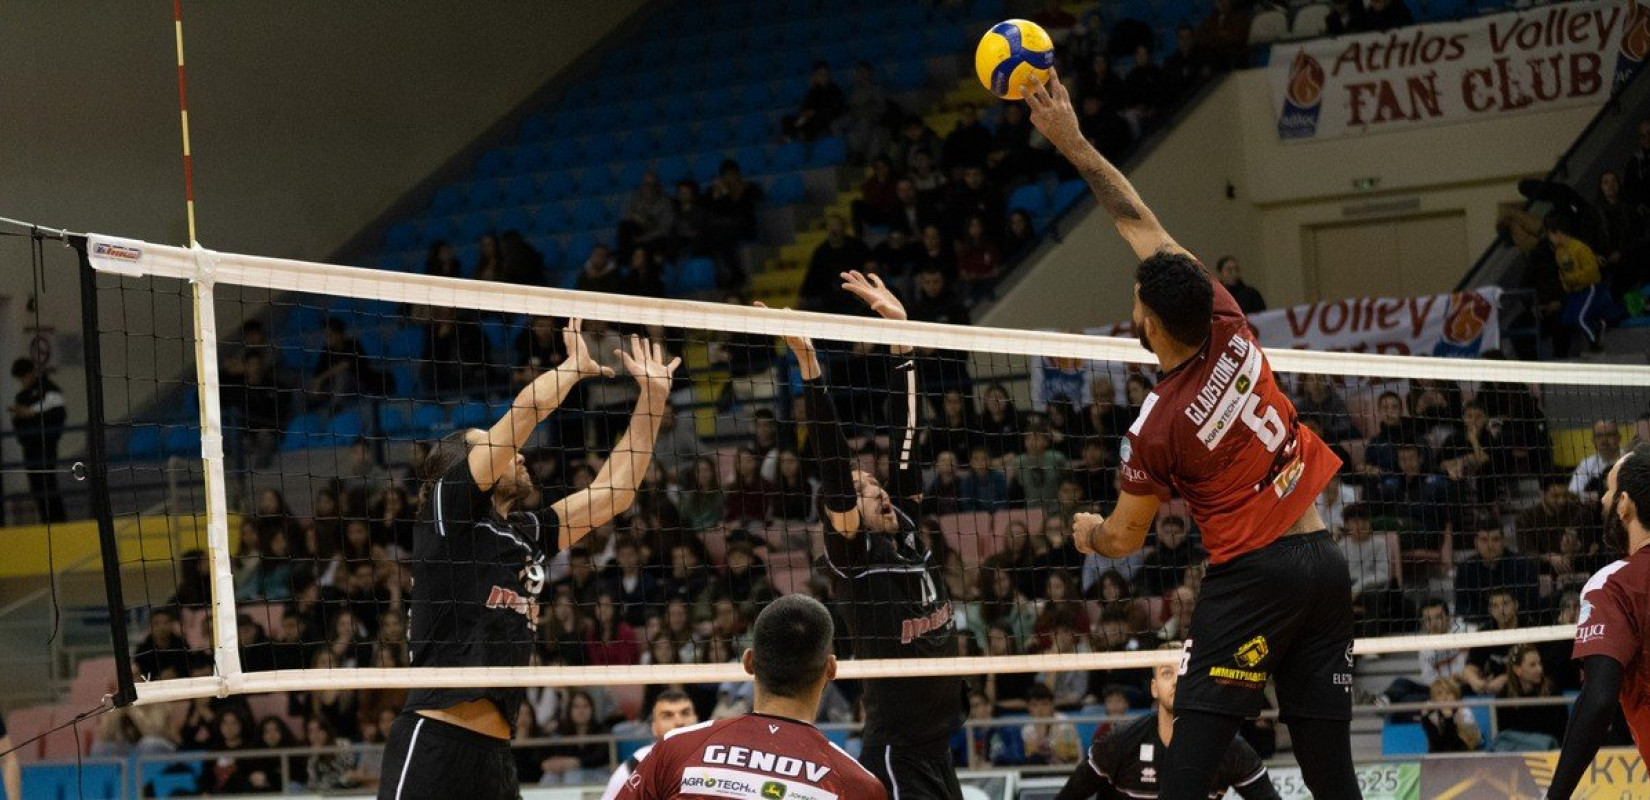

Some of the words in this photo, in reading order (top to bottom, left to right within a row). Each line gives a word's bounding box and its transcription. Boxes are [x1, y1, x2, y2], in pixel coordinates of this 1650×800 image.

[1331, 31, 1469, 77] Athlos
[1489, 7, 1621, 55] Volley
[1344, 71, 1443, 127] FAN
[1461, 52, 1602, 115] CLUB
[1184, 352, 1240, 427] GLADSTONE
[1241, 393, 1287, 453] 6
[682, 776, 749, 793] AGROTECH
[703, 744, 831, 783] GENOV
